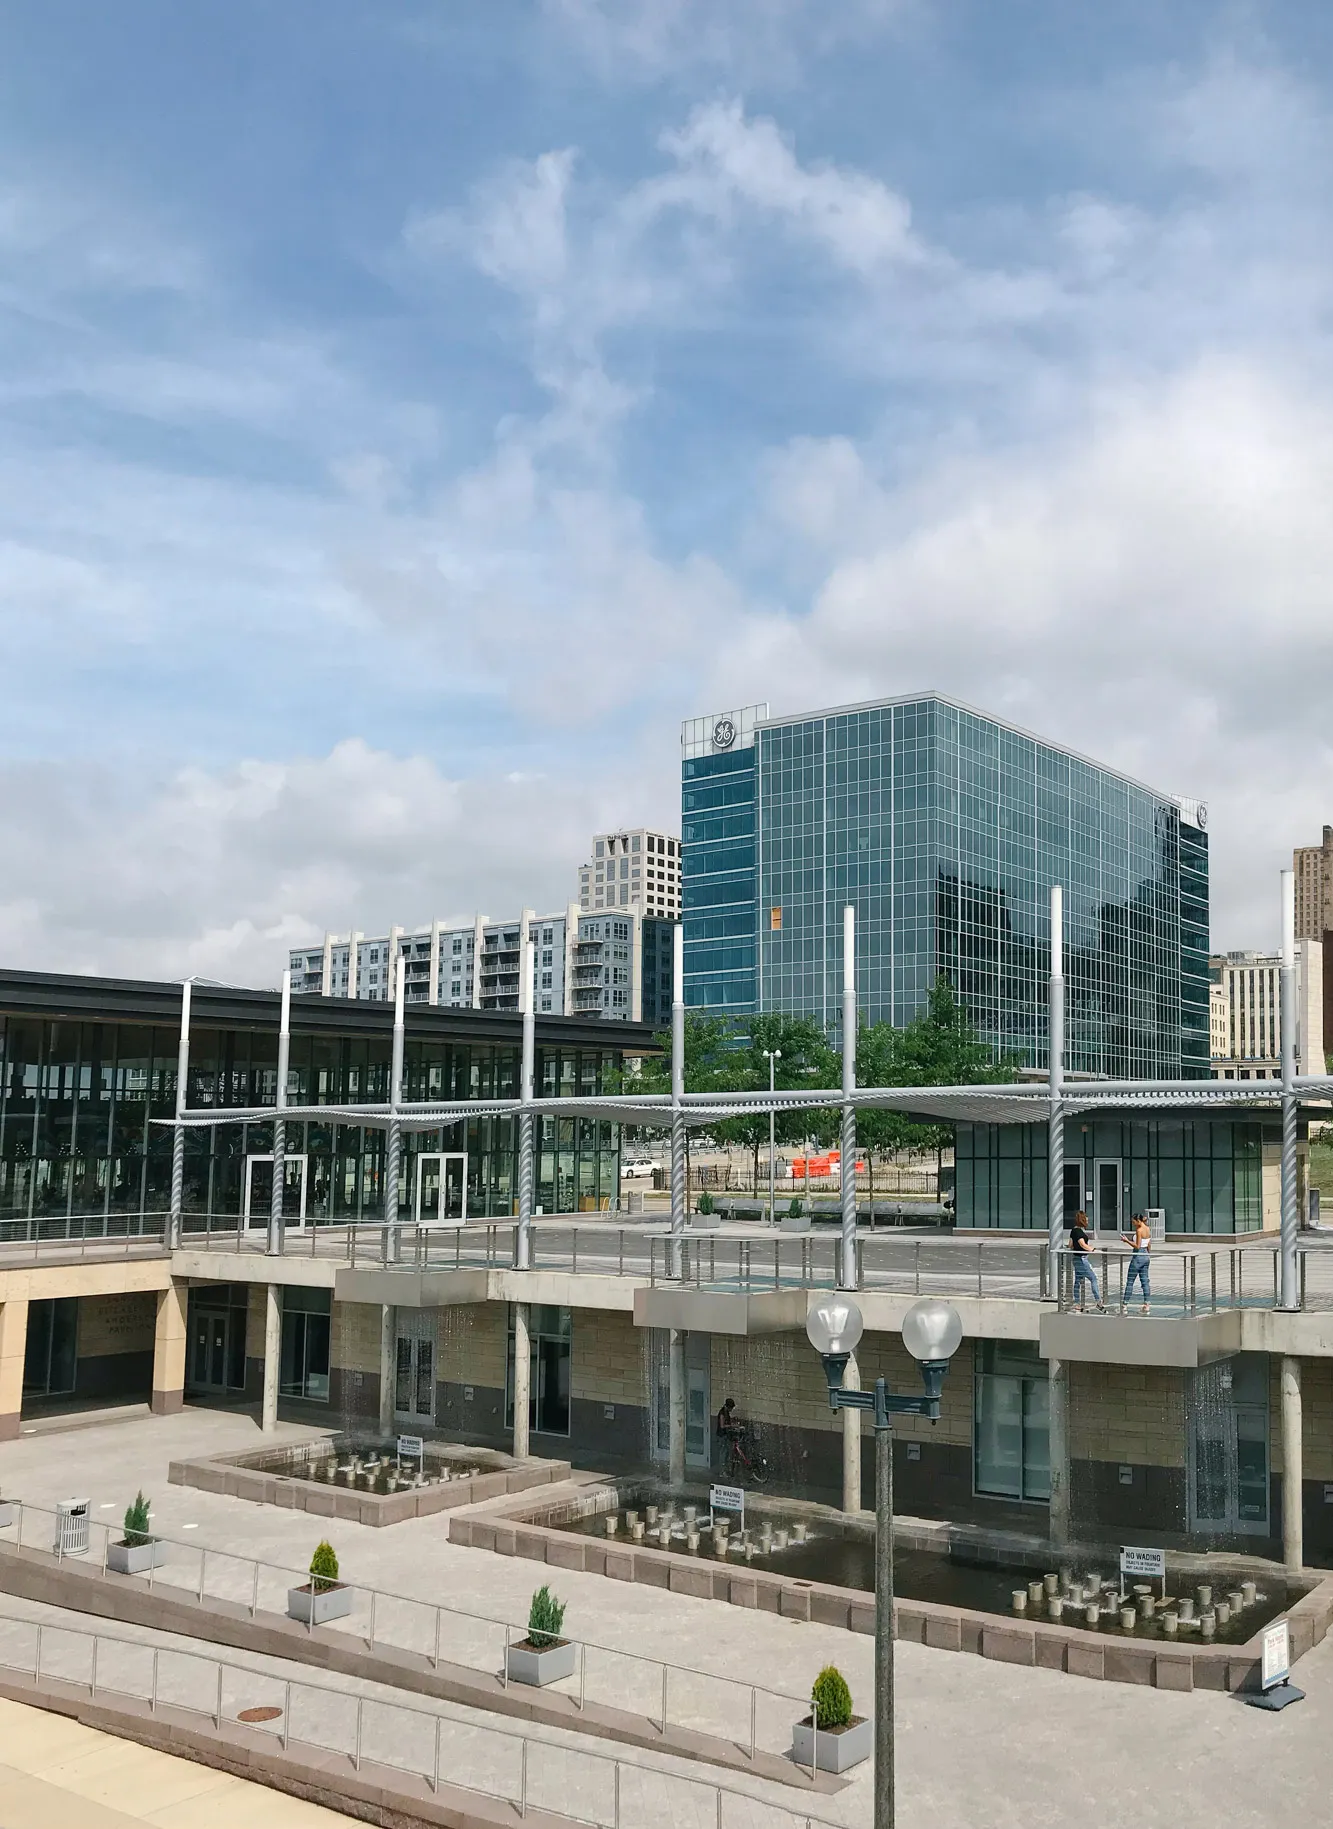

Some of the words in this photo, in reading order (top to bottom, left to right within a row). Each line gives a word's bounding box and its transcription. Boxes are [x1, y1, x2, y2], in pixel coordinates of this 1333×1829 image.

[723, 1490, 740, 1499] WADING
[1125, 1551, 1134, 1559] NO
[1136, 1552, 1161, 1562] WADING
